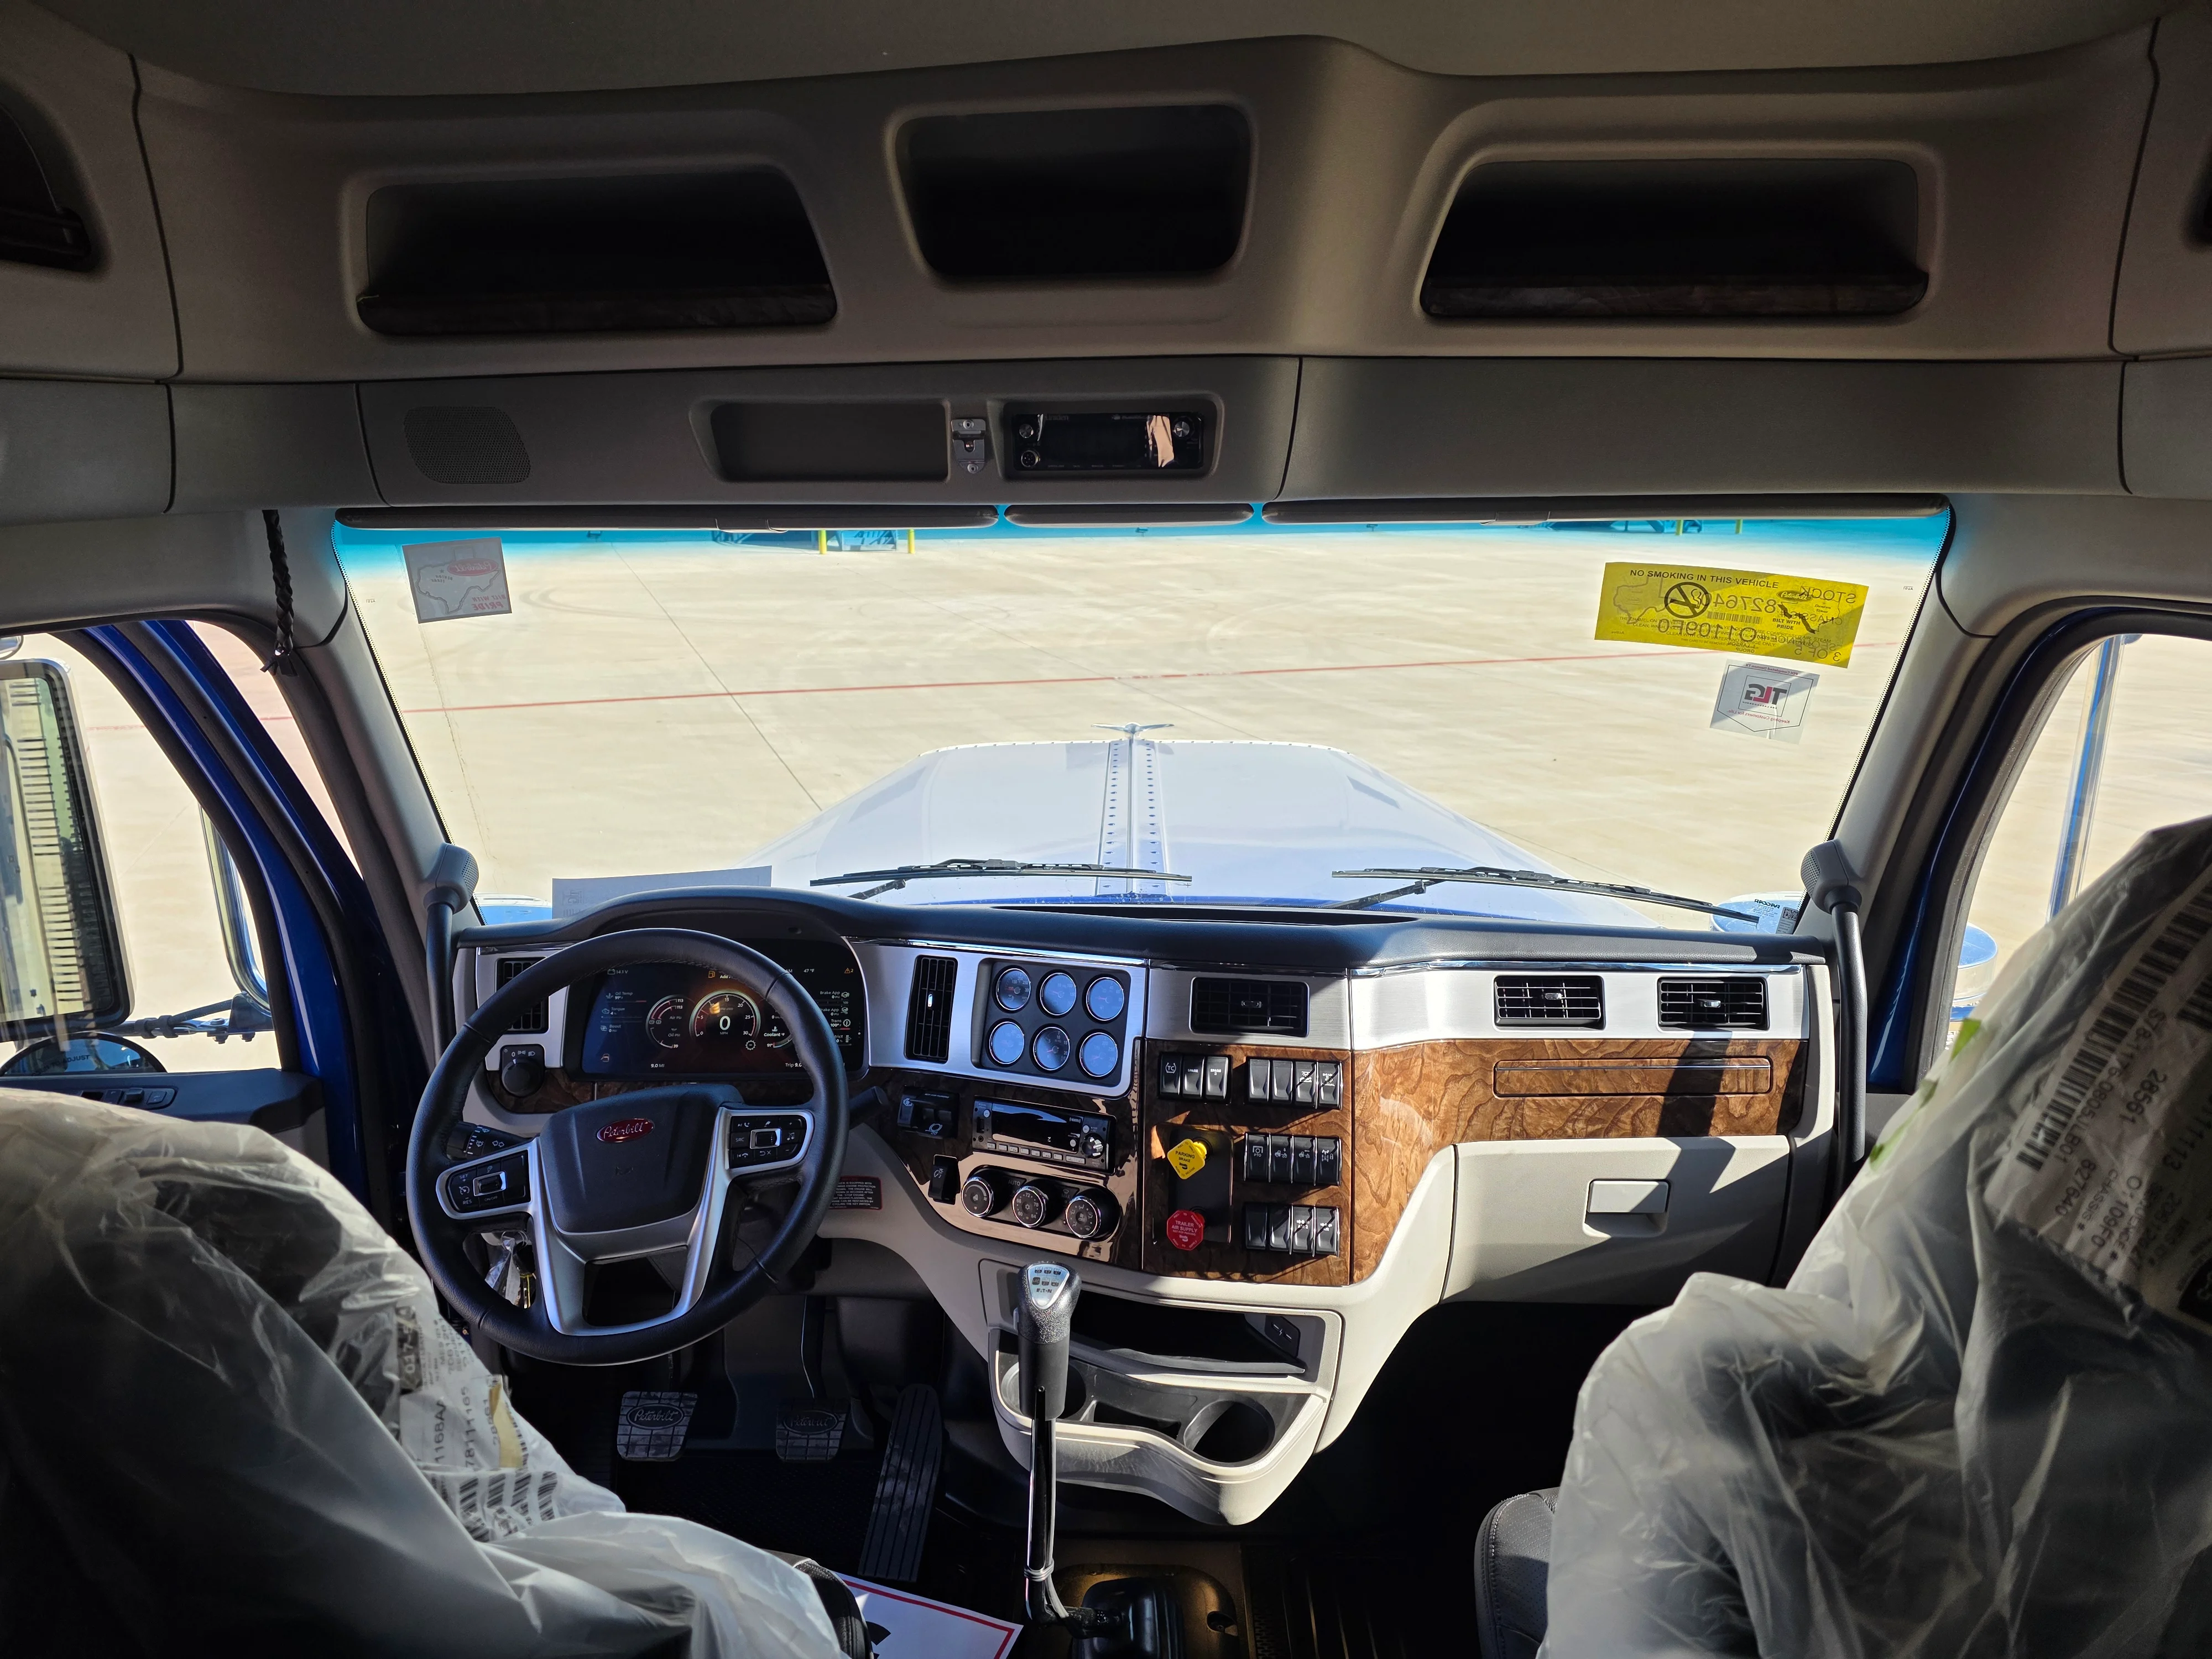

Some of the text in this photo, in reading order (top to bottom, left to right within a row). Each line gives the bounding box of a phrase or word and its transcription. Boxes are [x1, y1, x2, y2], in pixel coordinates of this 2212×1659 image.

[1647, 570, 1694, 580] SMOKING
[1709, 575, 1732, 583] THIS
[1735, 577, 1779, 588] VEHICLE
[1780, 591, 1808, 601] Peterbilt
[719, 1015, 731, 1030] 0
[2119, 1068, 2168, 1124] 28561
[603, 1123, 644, 1139] Peterbilt
[2055, 1159, 2096, 1216] 827640
[634, 1408, 679, 1423] Peterbilt
